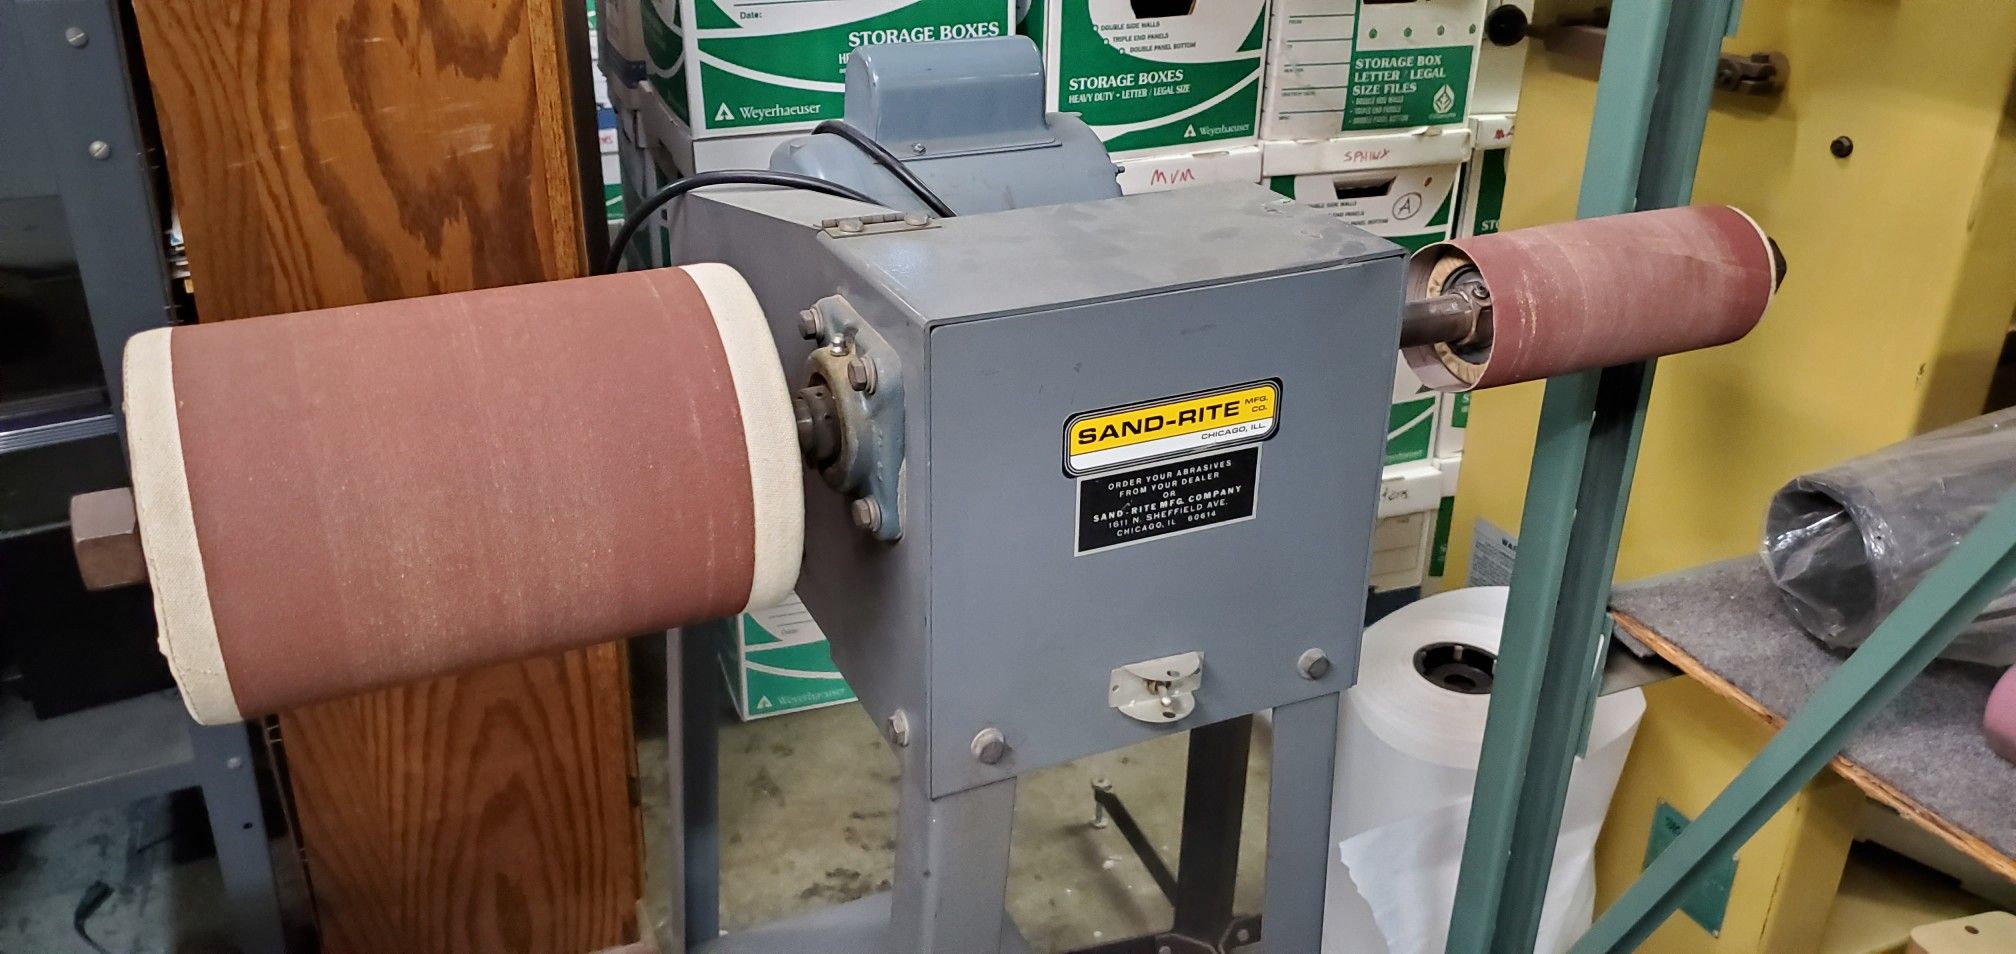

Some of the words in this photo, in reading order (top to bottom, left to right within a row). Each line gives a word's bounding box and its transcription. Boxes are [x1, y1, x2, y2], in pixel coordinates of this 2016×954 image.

[848, 28, 935, 47] STORAGE
[939, 22, 999, 40] BOXES
[1101, 23, 1124, 31] DOUBLE
[1130, 45, 1152, 53] DOUBLE
[1355, 56, 1414, 69] STORAGE
[1417, 55, 1442, 66] BOX
[1069, 73, 1135, 91] STORAGE
[1138, 69, 1184, 85] BOXES
[1354, 70, 1400, 82] LETTER
[1410, 68, 1446, 80] LEGAL
[1068, 92, 1095, 104] HEAVY
[1094, 91, 1114, 102] DUTY
[1122, 88, 1148, 99] LETTER
[1153, 85, 1175, 96] LEGAL
[1176, 83, 1191, 94] SIZE
[1352, 84, 1380, 96] SIZE
[1384, 82, 1417, 94] FILES
[740, 104, 821, 121] Weyerhaeuser
[1200, 124, 1249, 136] Weyerhaeuser
[1078, 400, 1240, 445] SAND-RITE
[1245, 396, 1268, 404] MFG.
[1201, 426, 1248, 439] CHICAGO,
[1108, 478, 1142, 490] ORDER
[1146, 472, 1173, 483] YOUR
[1176, 460, 1232, 477] ABRASIVES
[1120, 486, 1147, 498] FROM
[1151, 481, 1178, 491] YOUR
[1182, 472, 1219, 485] DEALER
[1163, 490, 1176, 499] OR
[1160, 498, 1184, 509] MFG.
[1188, 485, 1241, 503] COMPANY
[1109, 519, 1128, 529] 1611
[1146, 503, 1203, 521] SHEFFIELD
[1207, 499, 1228, 509] AVE.
[1117, 521, 1164, 537] CHICAGO,
[1188, 511, 1216, 522] 60614
